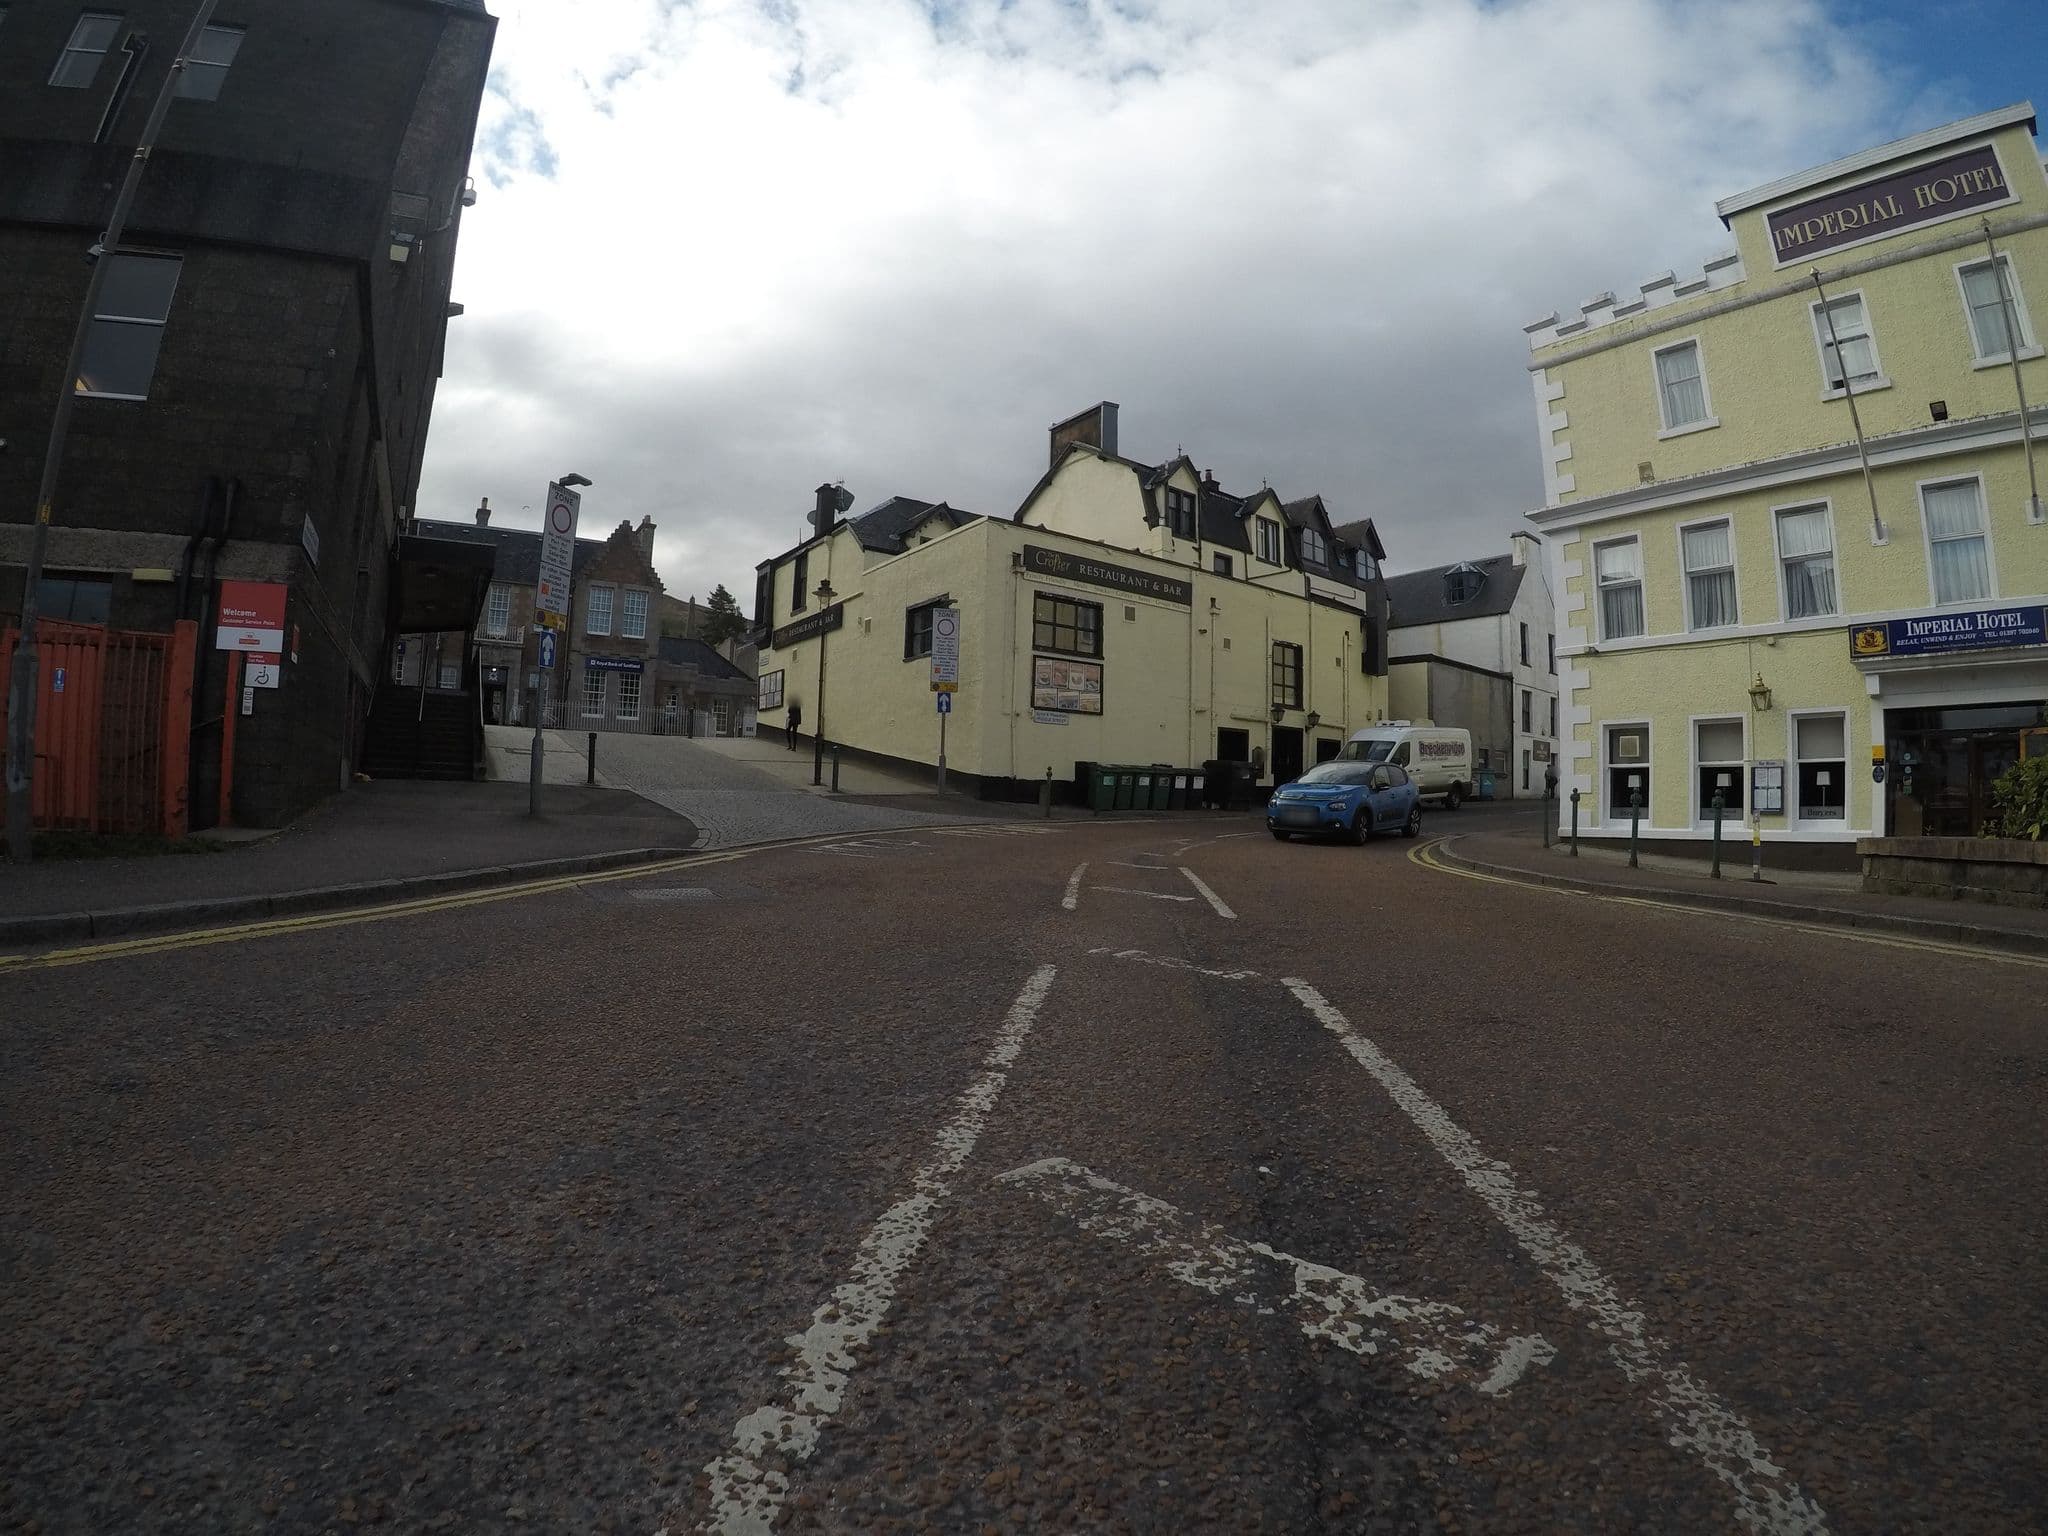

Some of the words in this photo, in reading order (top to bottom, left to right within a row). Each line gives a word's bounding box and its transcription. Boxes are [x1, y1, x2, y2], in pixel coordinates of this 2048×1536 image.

[1773, 195, 1904, 251] IMPERIAL
[1913, 166, 2004, 209] HOTEL
[555, 491, 574, 505] ZONE
[1035, 551, 1071, 571] Crofter
[1079, 563, 1149, 588] RESTAURANT
[1152, 581, 1160, 591] &
[1163, 585, 1182, 596] BAR
[223, 608, 257, 617] Welcome
[1905, 617, 1973, 636] IMPERIAL
[1976, 612, 2025, 630] HOTEL
[1920, 636, 1948, 644] UNWIND
